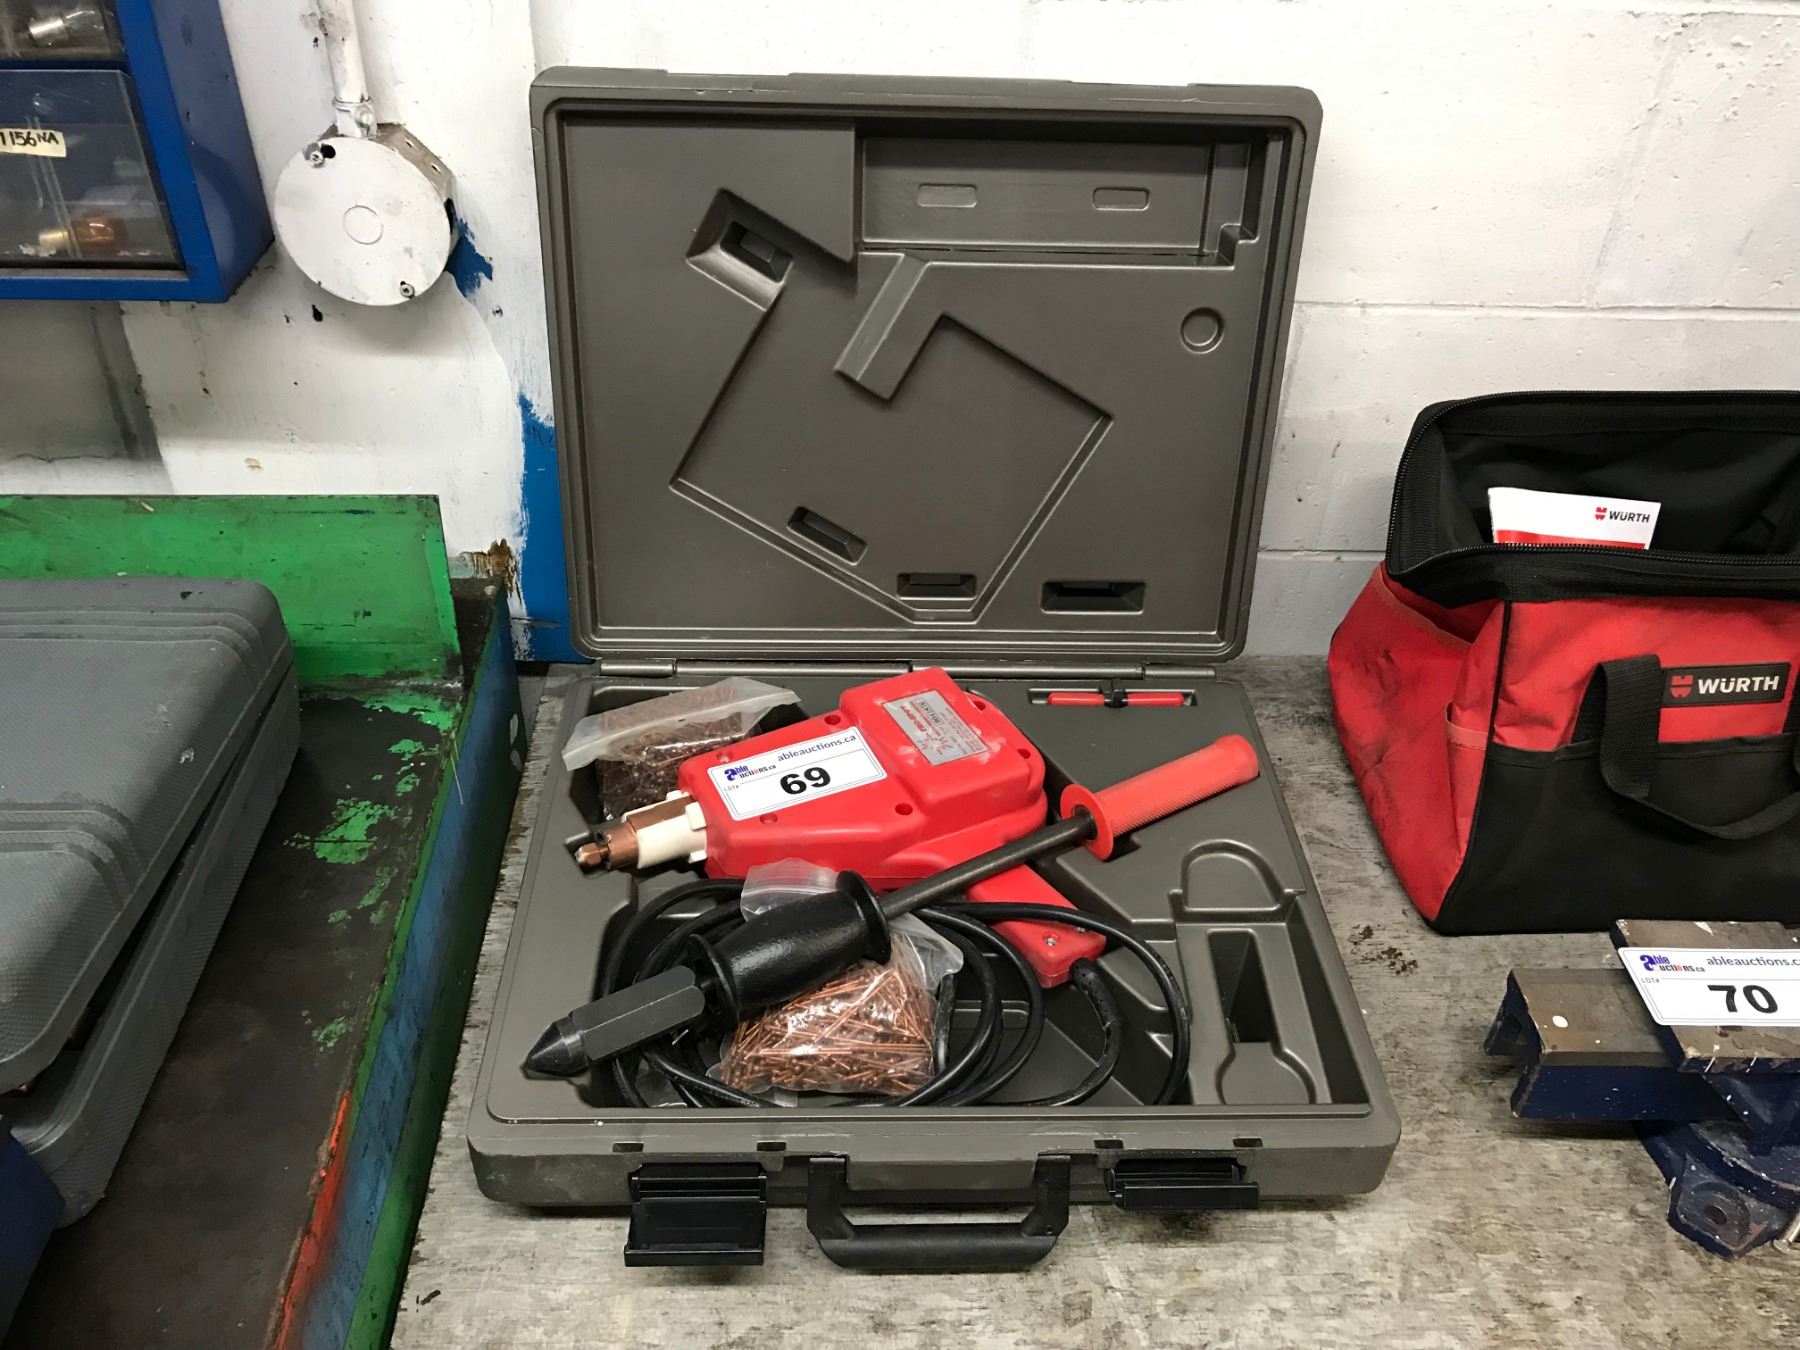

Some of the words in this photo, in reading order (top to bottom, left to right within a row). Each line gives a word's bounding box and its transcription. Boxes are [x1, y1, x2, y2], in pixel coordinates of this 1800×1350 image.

[1609, 511, 1650, 523] WÜRTH
[1698, 676, 1779, 694] WÜRTH
[777, 735, 856, 762] ableauctions.ca
[780, 767, 830, 795] 69
[1706, 956, 1800, 966] ableauctions.c
[1707, 985, 1778, 1014] 70
